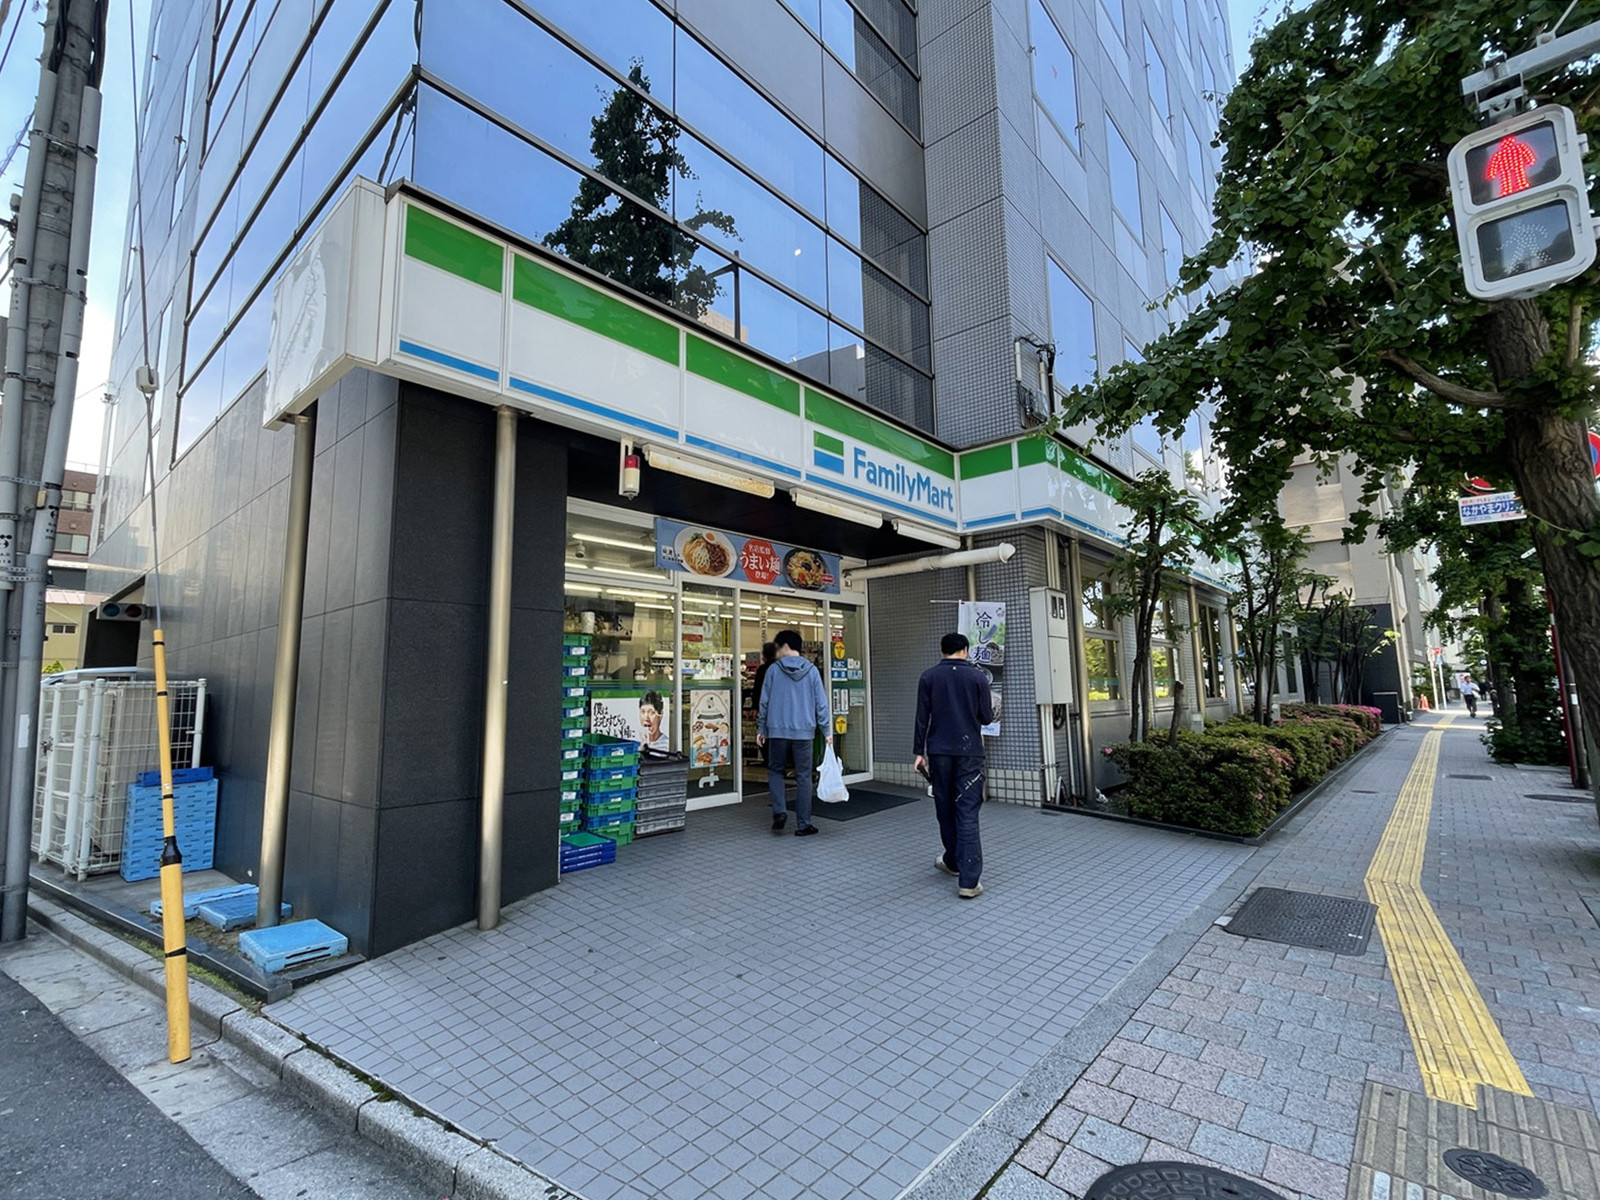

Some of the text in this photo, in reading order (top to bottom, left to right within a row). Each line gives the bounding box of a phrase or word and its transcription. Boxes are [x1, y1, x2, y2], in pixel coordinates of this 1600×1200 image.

[853, 446, 954, 512] FamilyMart
[1462, 501, 1524, 516] なかやまクリ
[740, 551, 780, 575] うまい麺
[974, 611, 992, 665] 冷し麺
